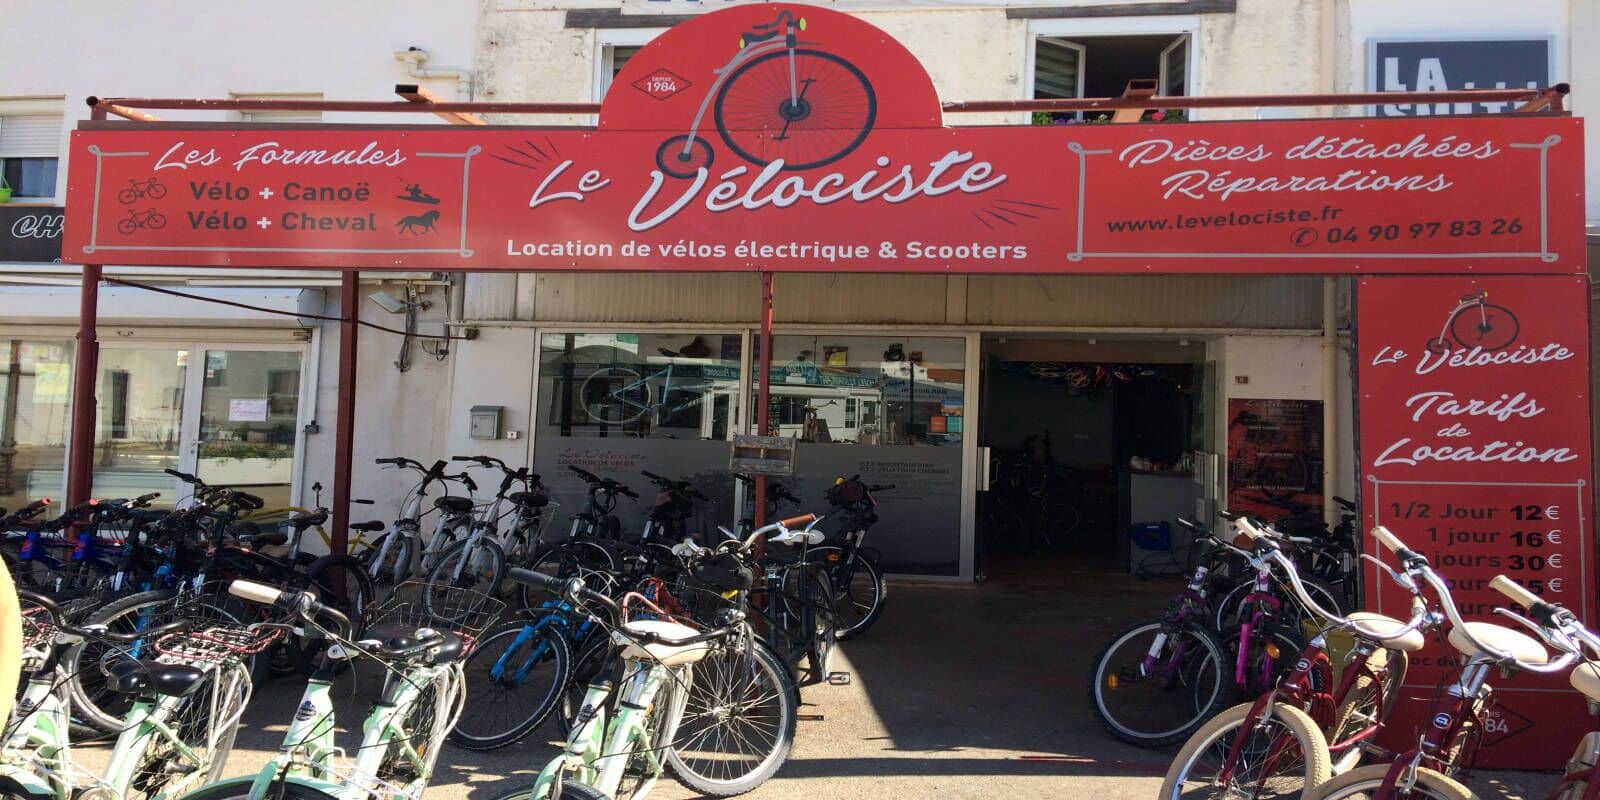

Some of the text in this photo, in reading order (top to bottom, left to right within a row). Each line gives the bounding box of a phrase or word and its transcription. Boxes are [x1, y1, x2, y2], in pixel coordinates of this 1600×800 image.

[647, 81, 677, 93] 1984
[1384, 56, 1450, 93] LA
[154, 141, 406, 171] Les Formules
[1119, 135, 1500, 169] Pièces détachées
[190, 182, 370, 202] Vélo + Canoë
[529, 151, 1008, 232] Le Vélociste
[1162, 168, 1454, 201] Réparations
[11, 215, 65, 238] CH
[188, 212, 377, 232] Vélo + Cheval
[1107, 208, 1344, 233] www.levelociste.fr
[1327, 218, 1523, 244] 04 90 97 83 26
[507, 239, 1027, 263] Location de vélos électrique & Scooters
[1372, 343, 1574, 375] Le Vélociste
[1406, 391, 1545, 422] Tarifs
[1437, 423, 1471, 437] de
[1374, 438, 1578, 467] Location
[1392, 503, 1430, 519] 1/2
[1440, 504, 1498, 520] Jour
[1427, 528, 1437, 542] 1
[1447, 529, 1501, 546] jour
[1485, 718, 1508, 733] 84
